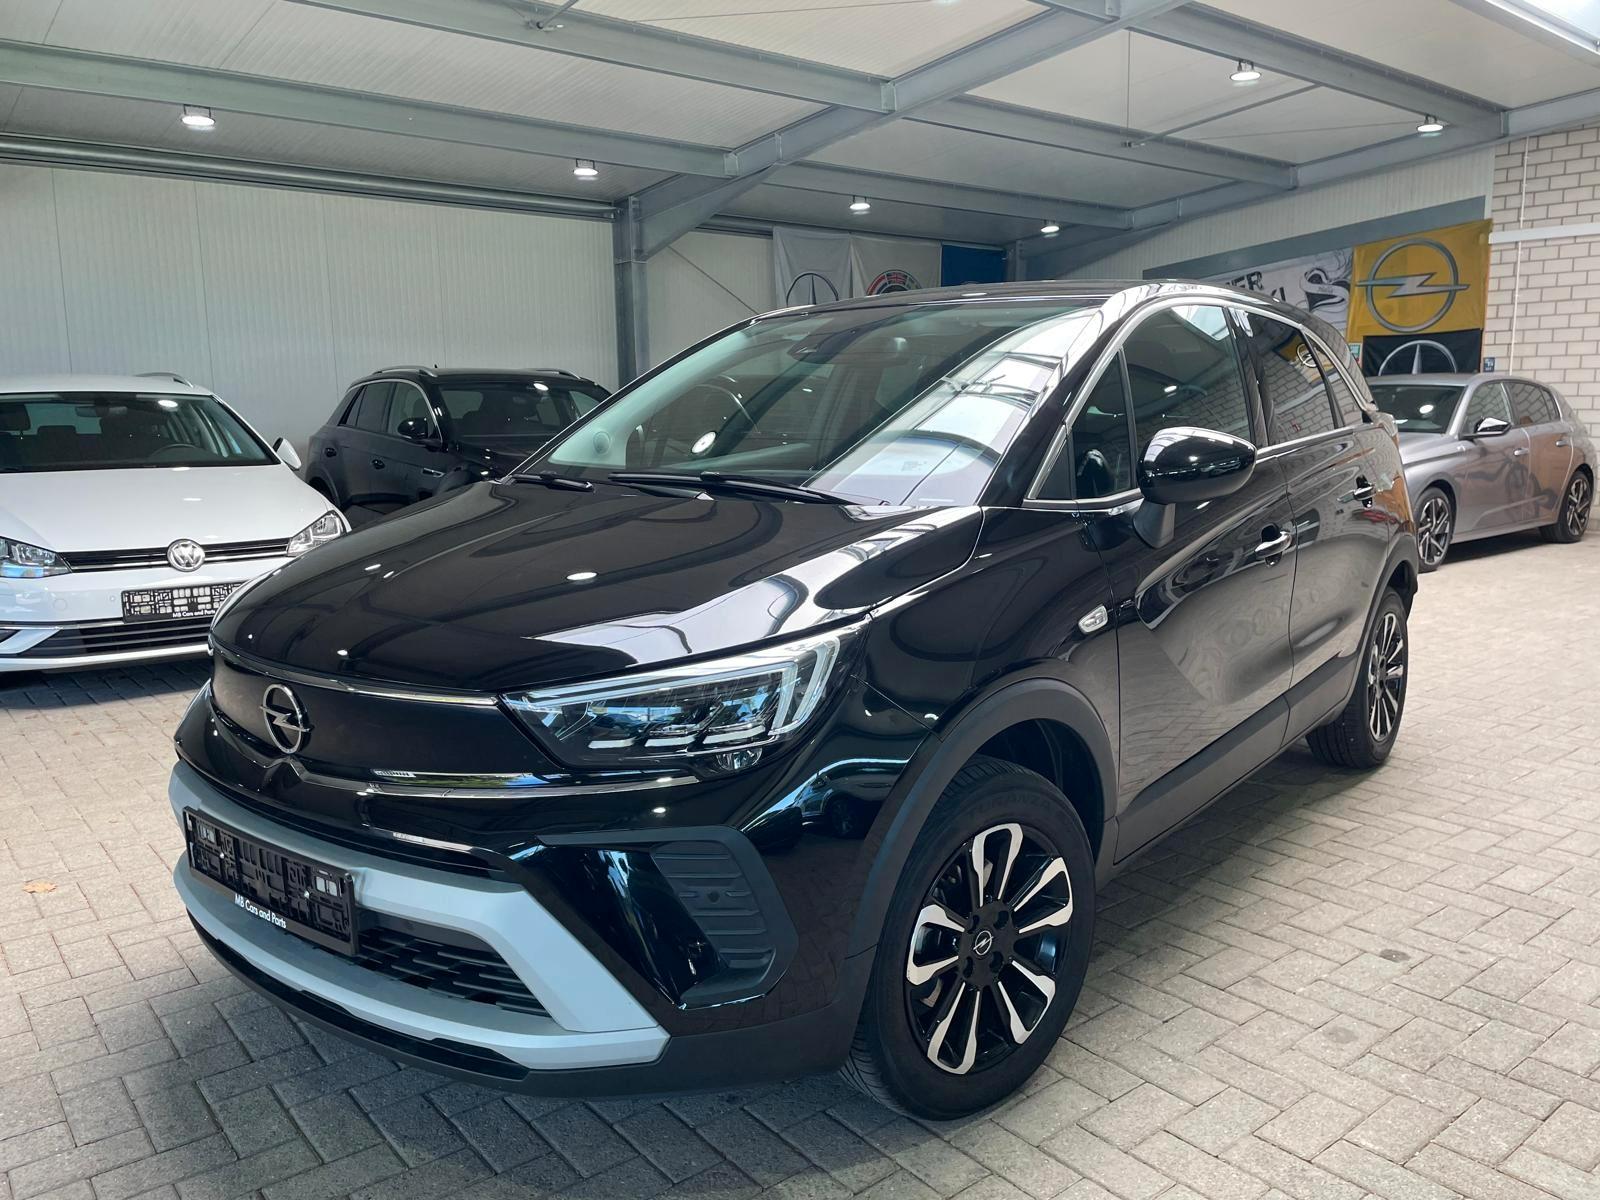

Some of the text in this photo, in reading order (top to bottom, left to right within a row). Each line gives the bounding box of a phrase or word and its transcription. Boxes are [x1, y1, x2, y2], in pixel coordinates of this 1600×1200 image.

[235, 893, 286, 928] MB Cars and Parts
